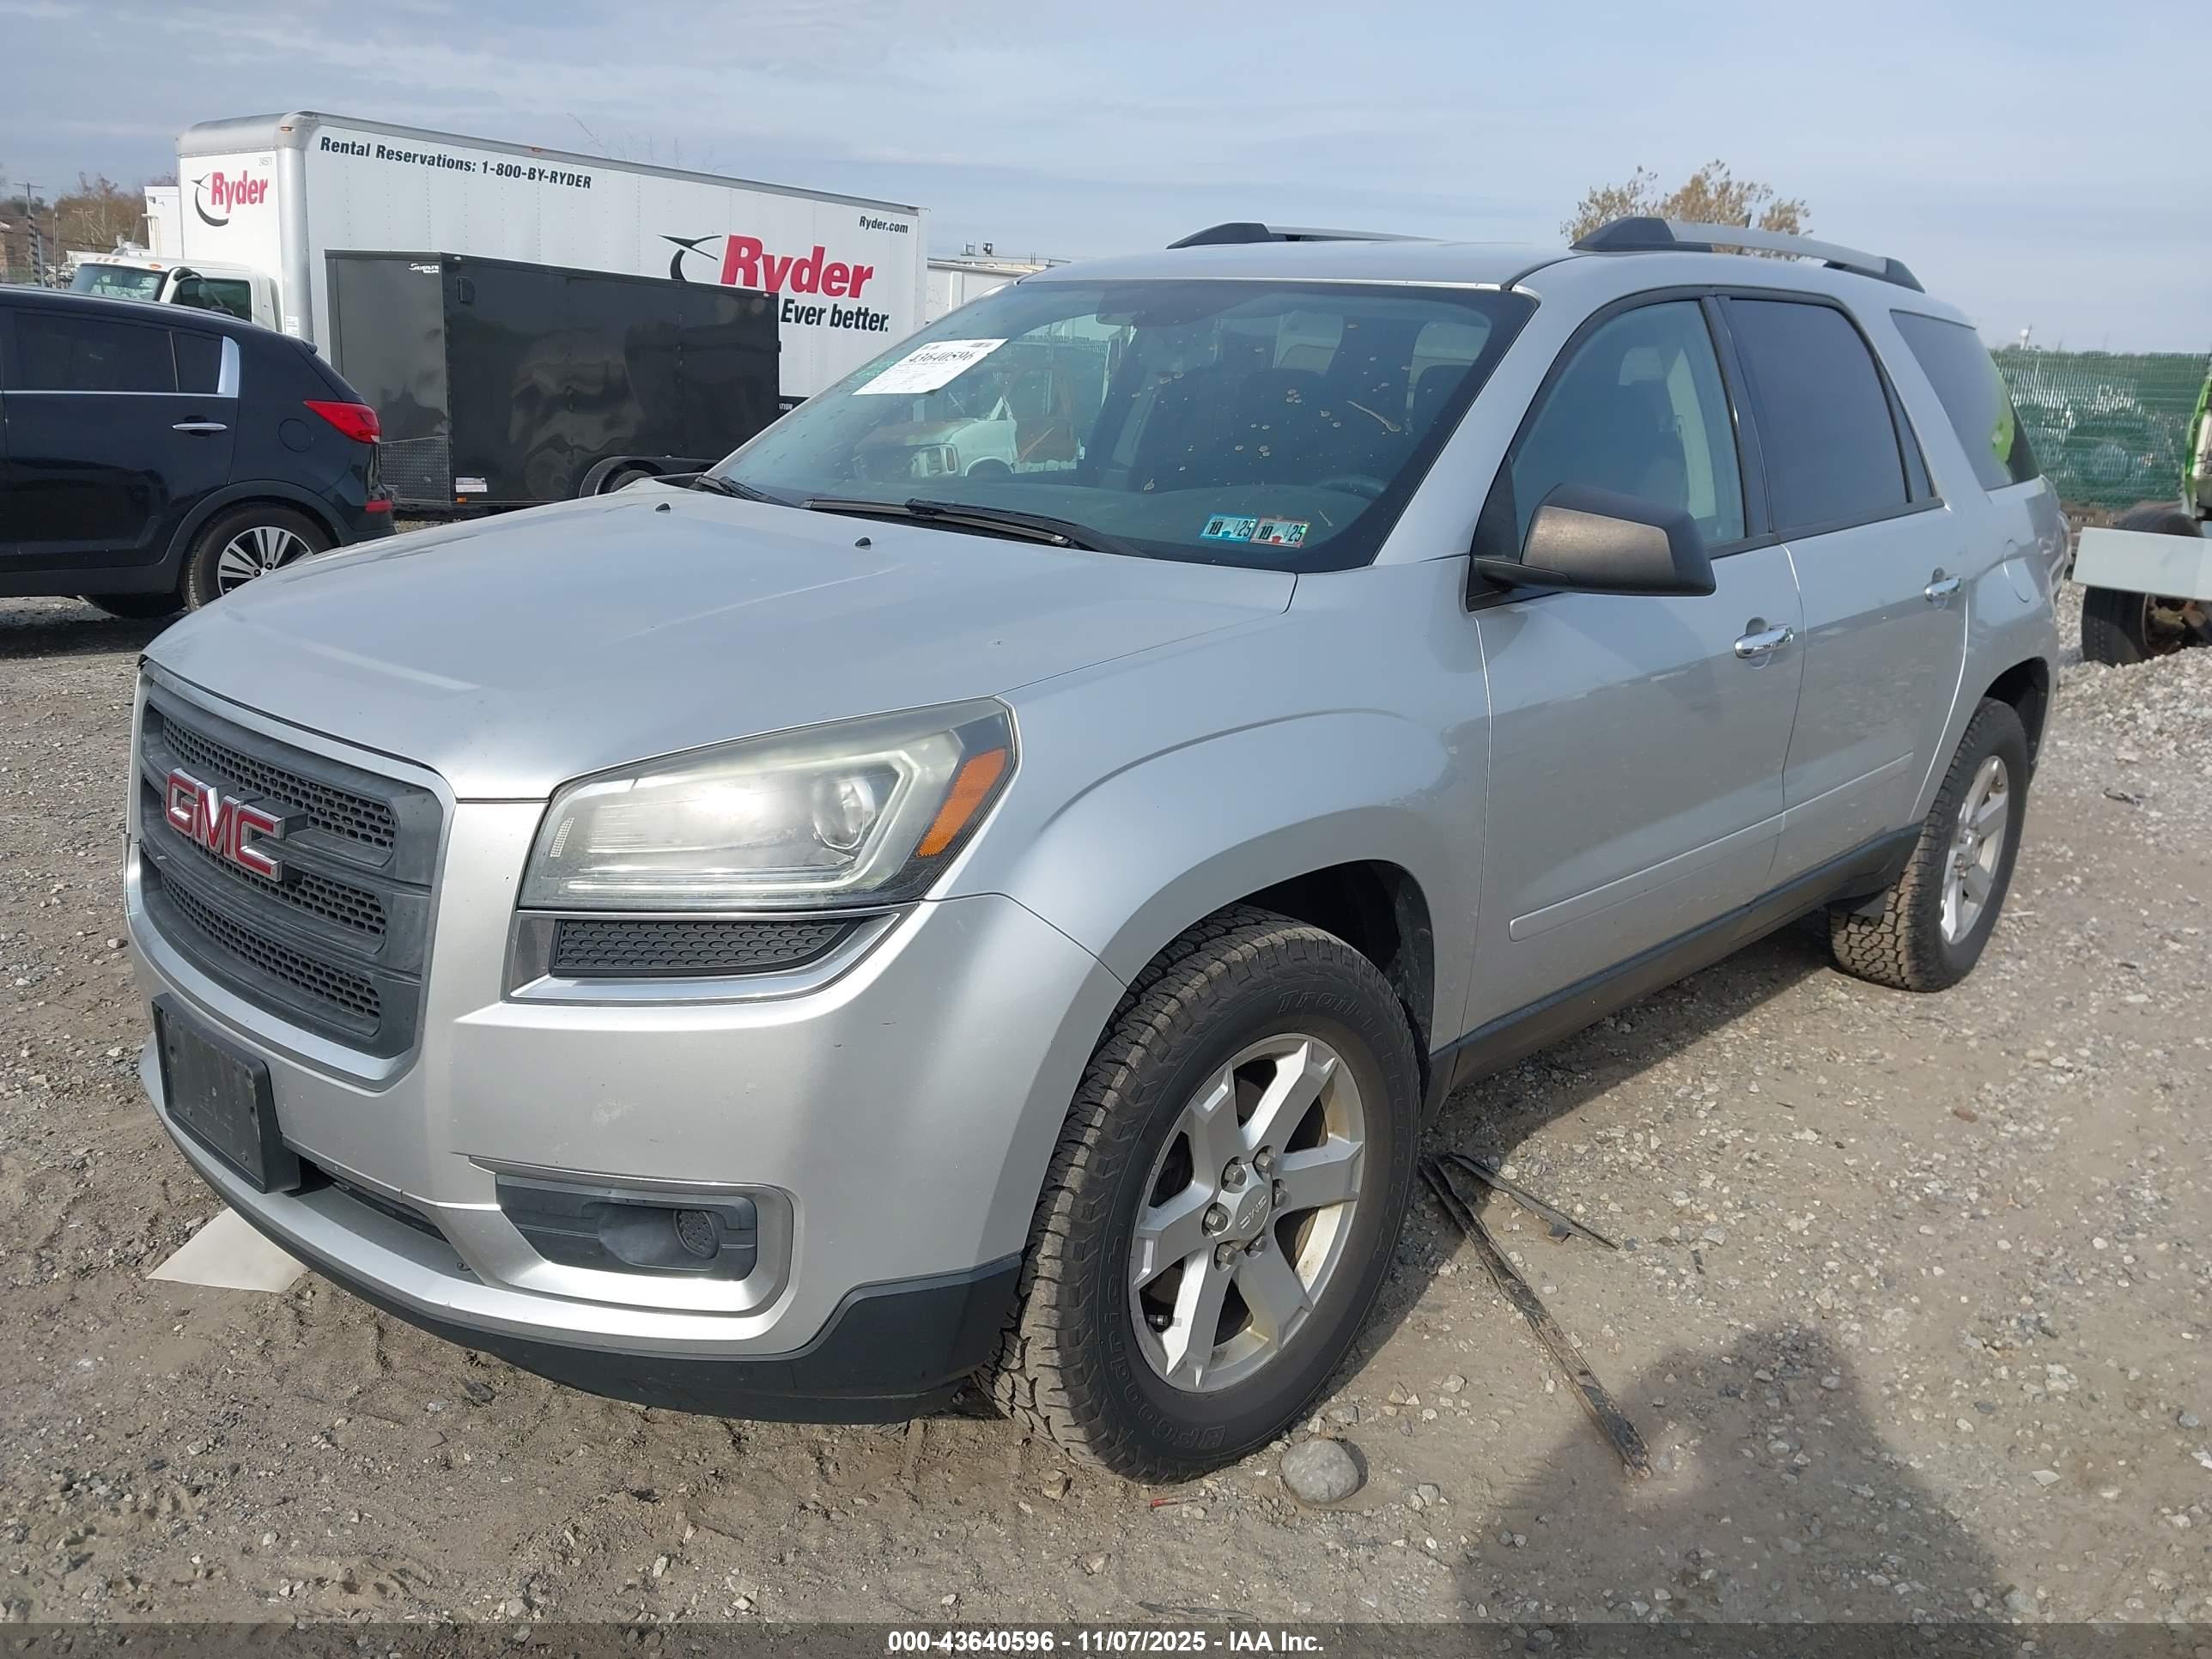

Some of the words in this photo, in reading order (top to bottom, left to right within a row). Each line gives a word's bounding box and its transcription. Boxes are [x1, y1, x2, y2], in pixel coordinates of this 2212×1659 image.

[319, 136, 371, 157] Rental
[375, 144, 477, 173] Reservations:
[481, 160, 592, 189] 1-800-BY-RYDER
[211, 170, 269, 214] Ryder
[859, 216, 908, 234] Ryder.com
[720, 234, 874, 299] Ryder
[781, 298, 826, 326] Ever
[829, 303, 890, 332] better.
[1208, 520, 1224, 535] 10
[1237, 520, 1255, 537] 25
[1258, 525, 1273, 540] 10
[1288, 525, 1305, 542] 25
[166, 768, 285, 883] GMC
[1239, 1194, 1267, 1230] GMC
